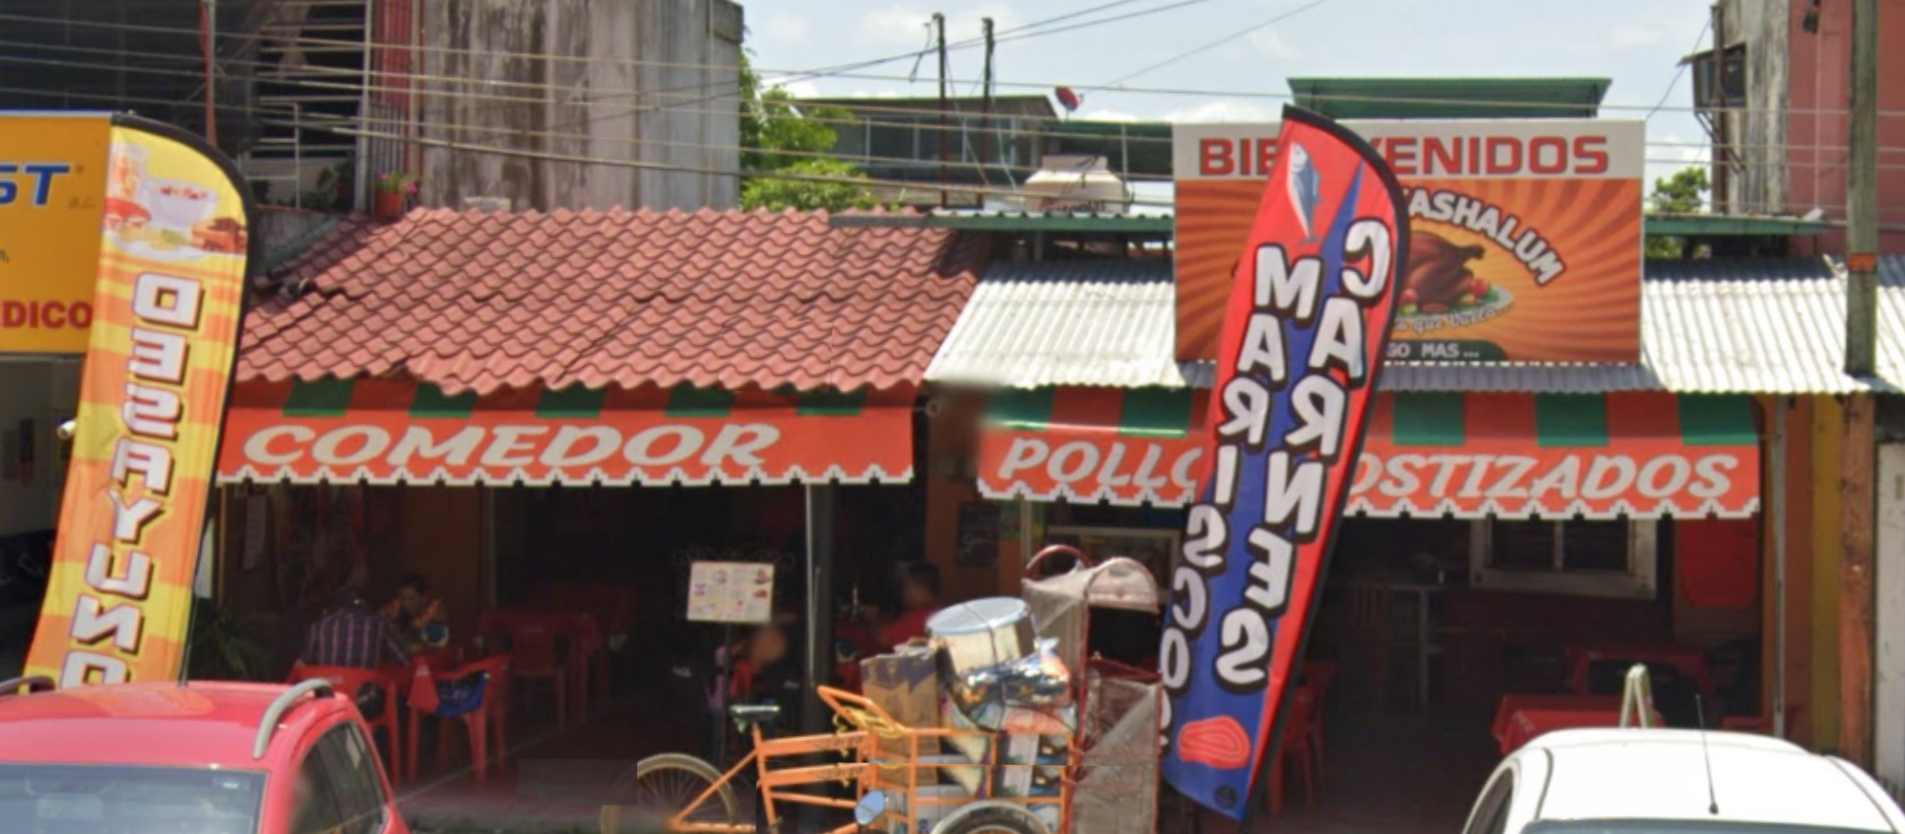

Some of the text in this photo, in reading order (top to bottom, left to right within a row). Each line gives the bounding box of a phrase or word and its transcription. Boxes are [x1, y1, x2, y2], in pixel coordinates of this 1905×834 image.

[1199, 136, 1608, 176] BIEENIDOS
[1402, 186, 1566, 285] ASHALUM
[243, 423, 781, 467] COMEDOR
